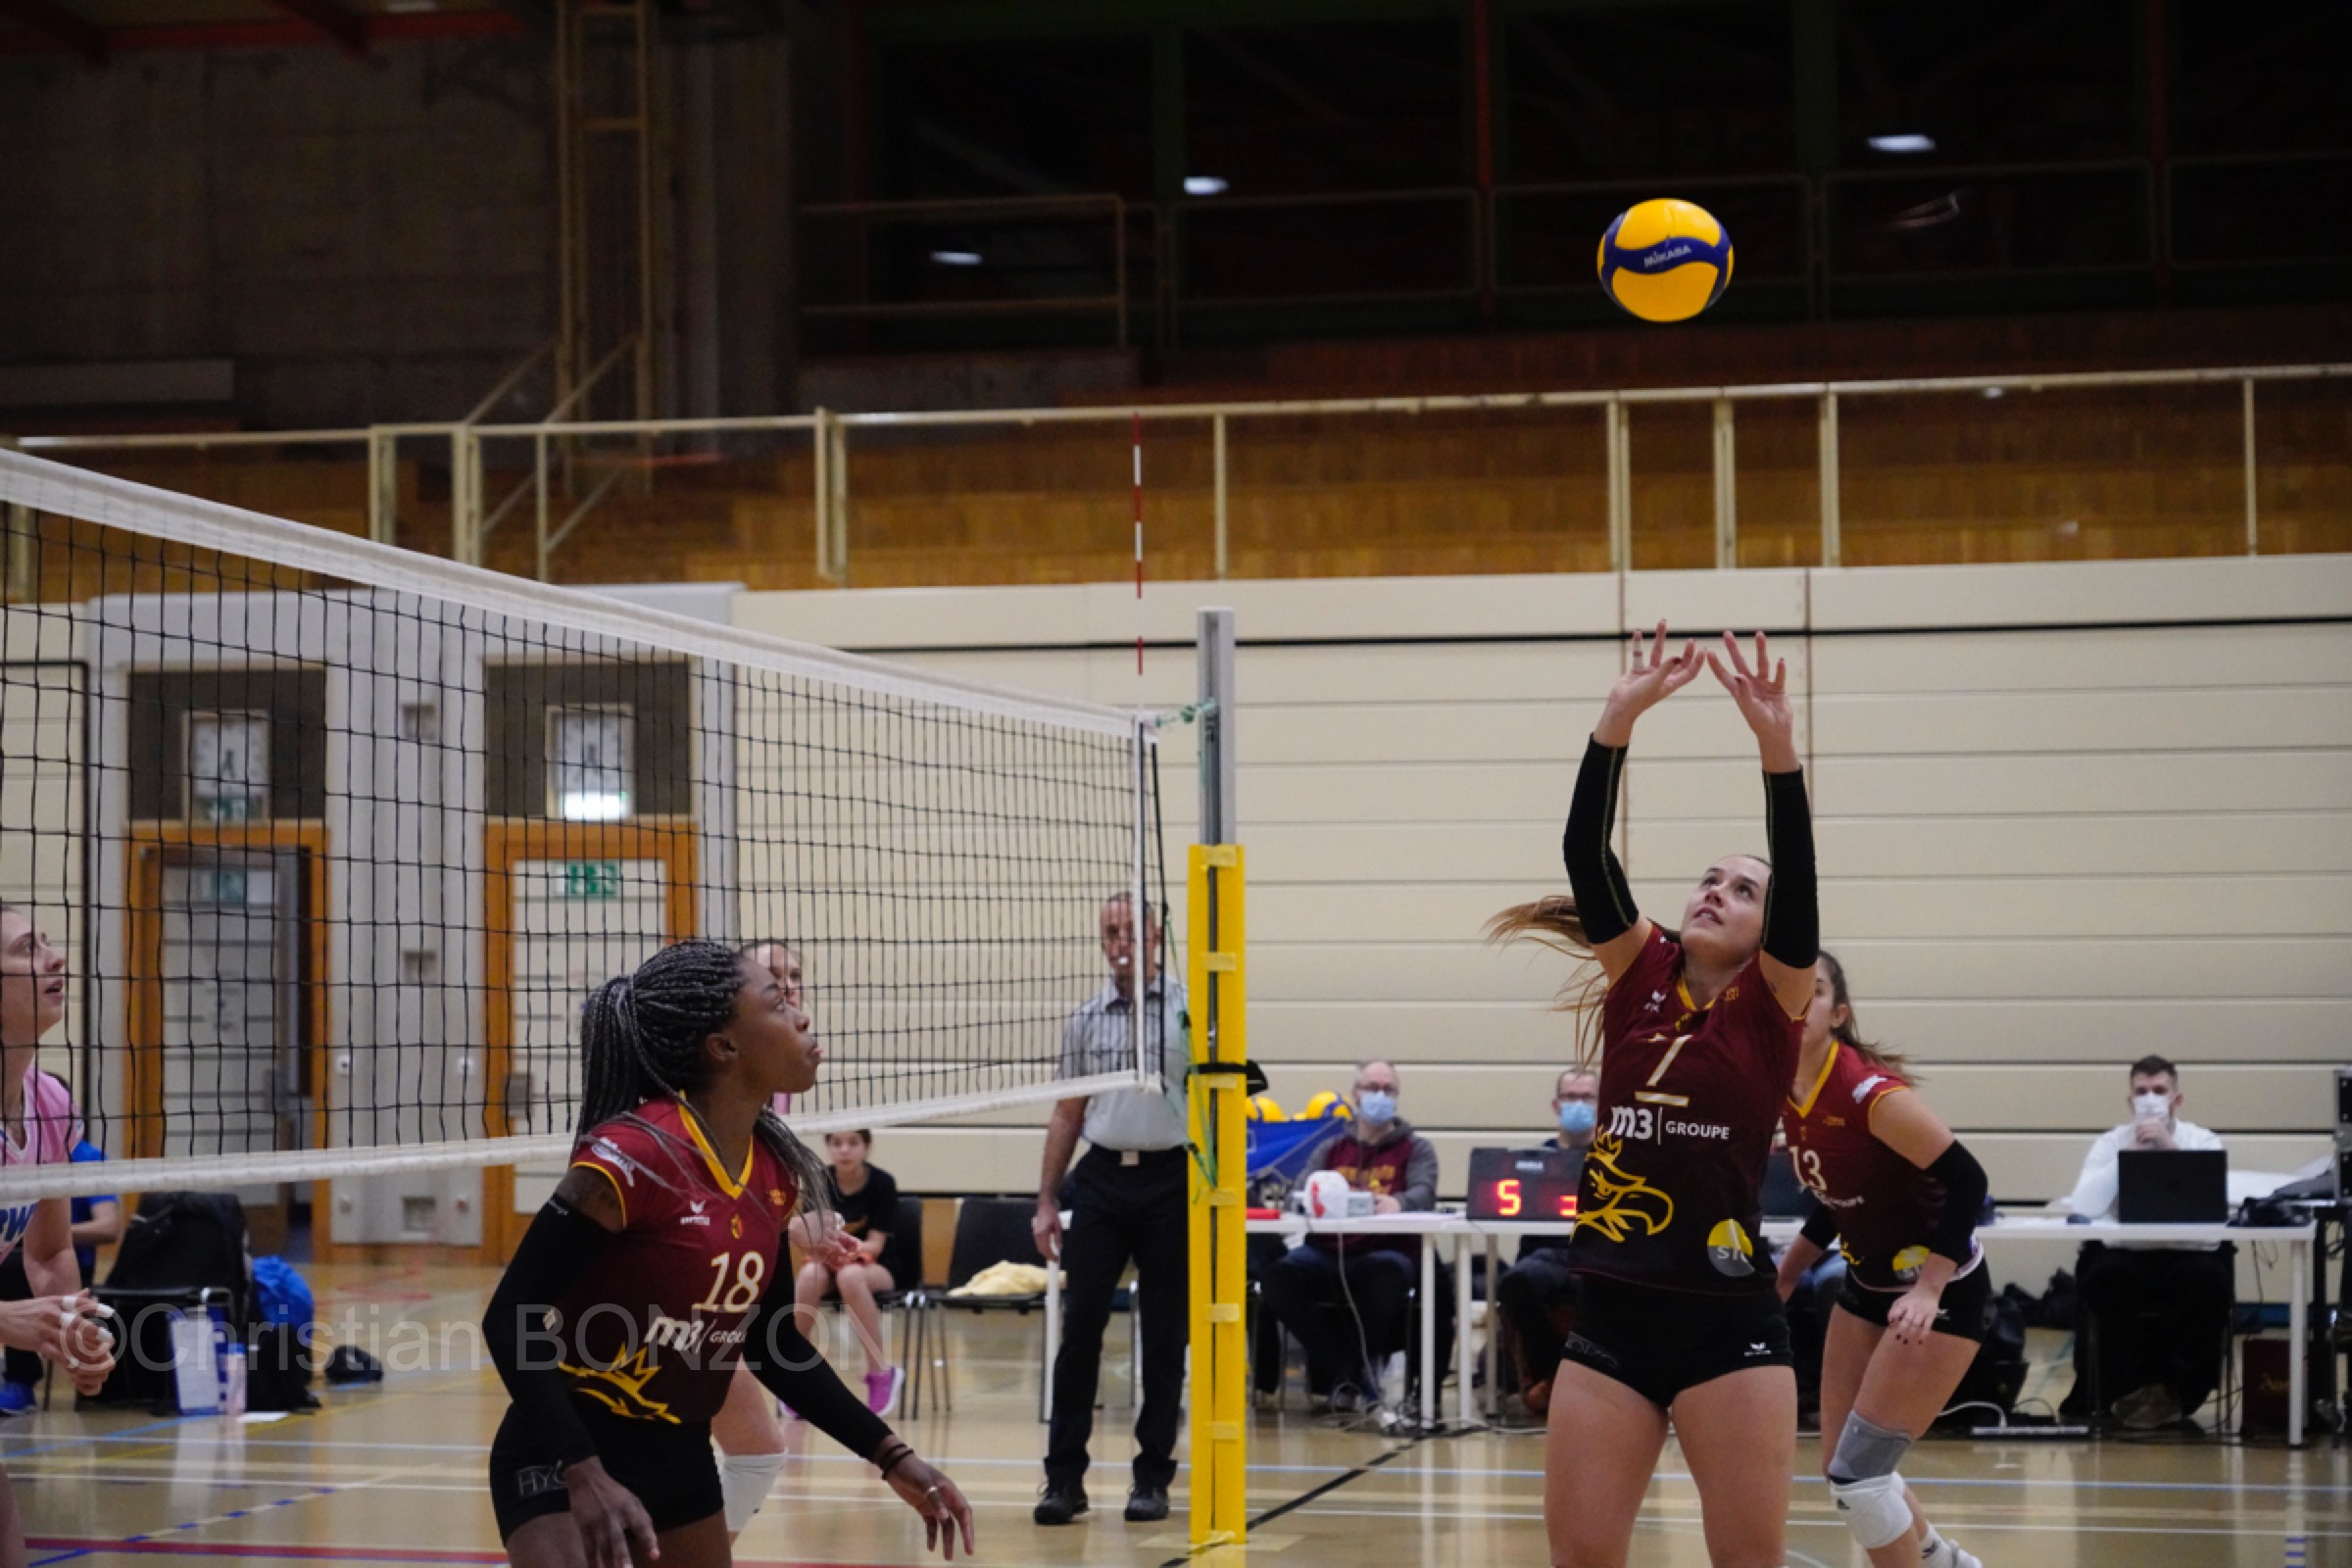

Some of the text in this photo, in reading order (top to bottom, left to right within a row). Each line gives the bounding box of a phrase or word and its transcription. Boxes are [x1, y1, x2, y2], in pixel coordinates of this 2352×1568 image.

[1665, 1120, 1732, 1140] GROUPE
[1788, 1146, 1828, 1192] 13
[1496, 1178, 1522, 1216] 5
[692, 1250, 764, 1313] 18
